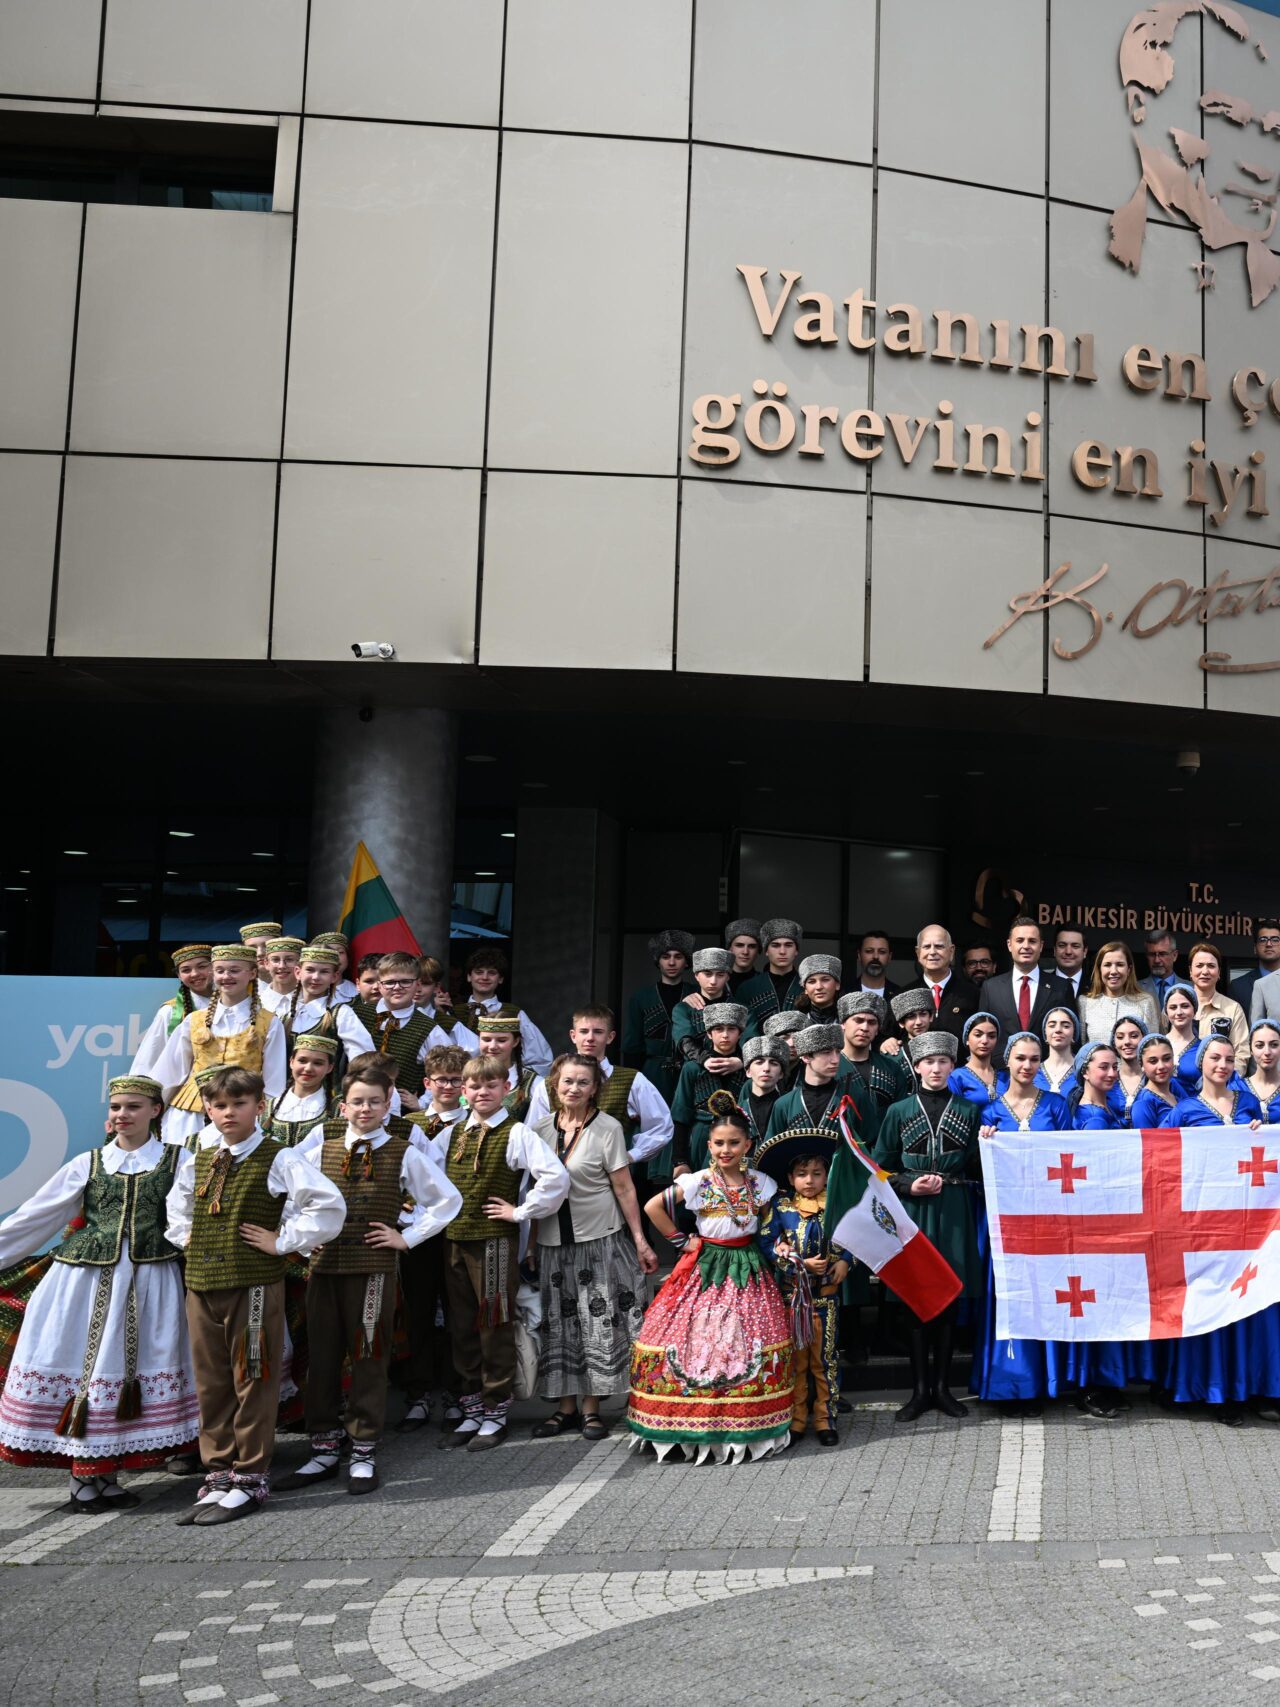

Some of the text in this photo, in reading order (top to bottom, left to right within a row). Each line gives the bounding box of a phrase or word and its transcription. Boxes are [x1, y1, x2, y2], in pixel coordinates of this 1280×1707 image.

[737, 264, 1098, 383] Vatanını
[1122, 343, 1212, 402] en
[687, 378, 1046, 483] görevini
[1072, 438, 1163, 498] en
[1185, 438, 1271, 526] iyi
[1144, 907, 1253, 936] BÜYÜKŞEHİR
[1189, 882, 1220, 905] T.C.
